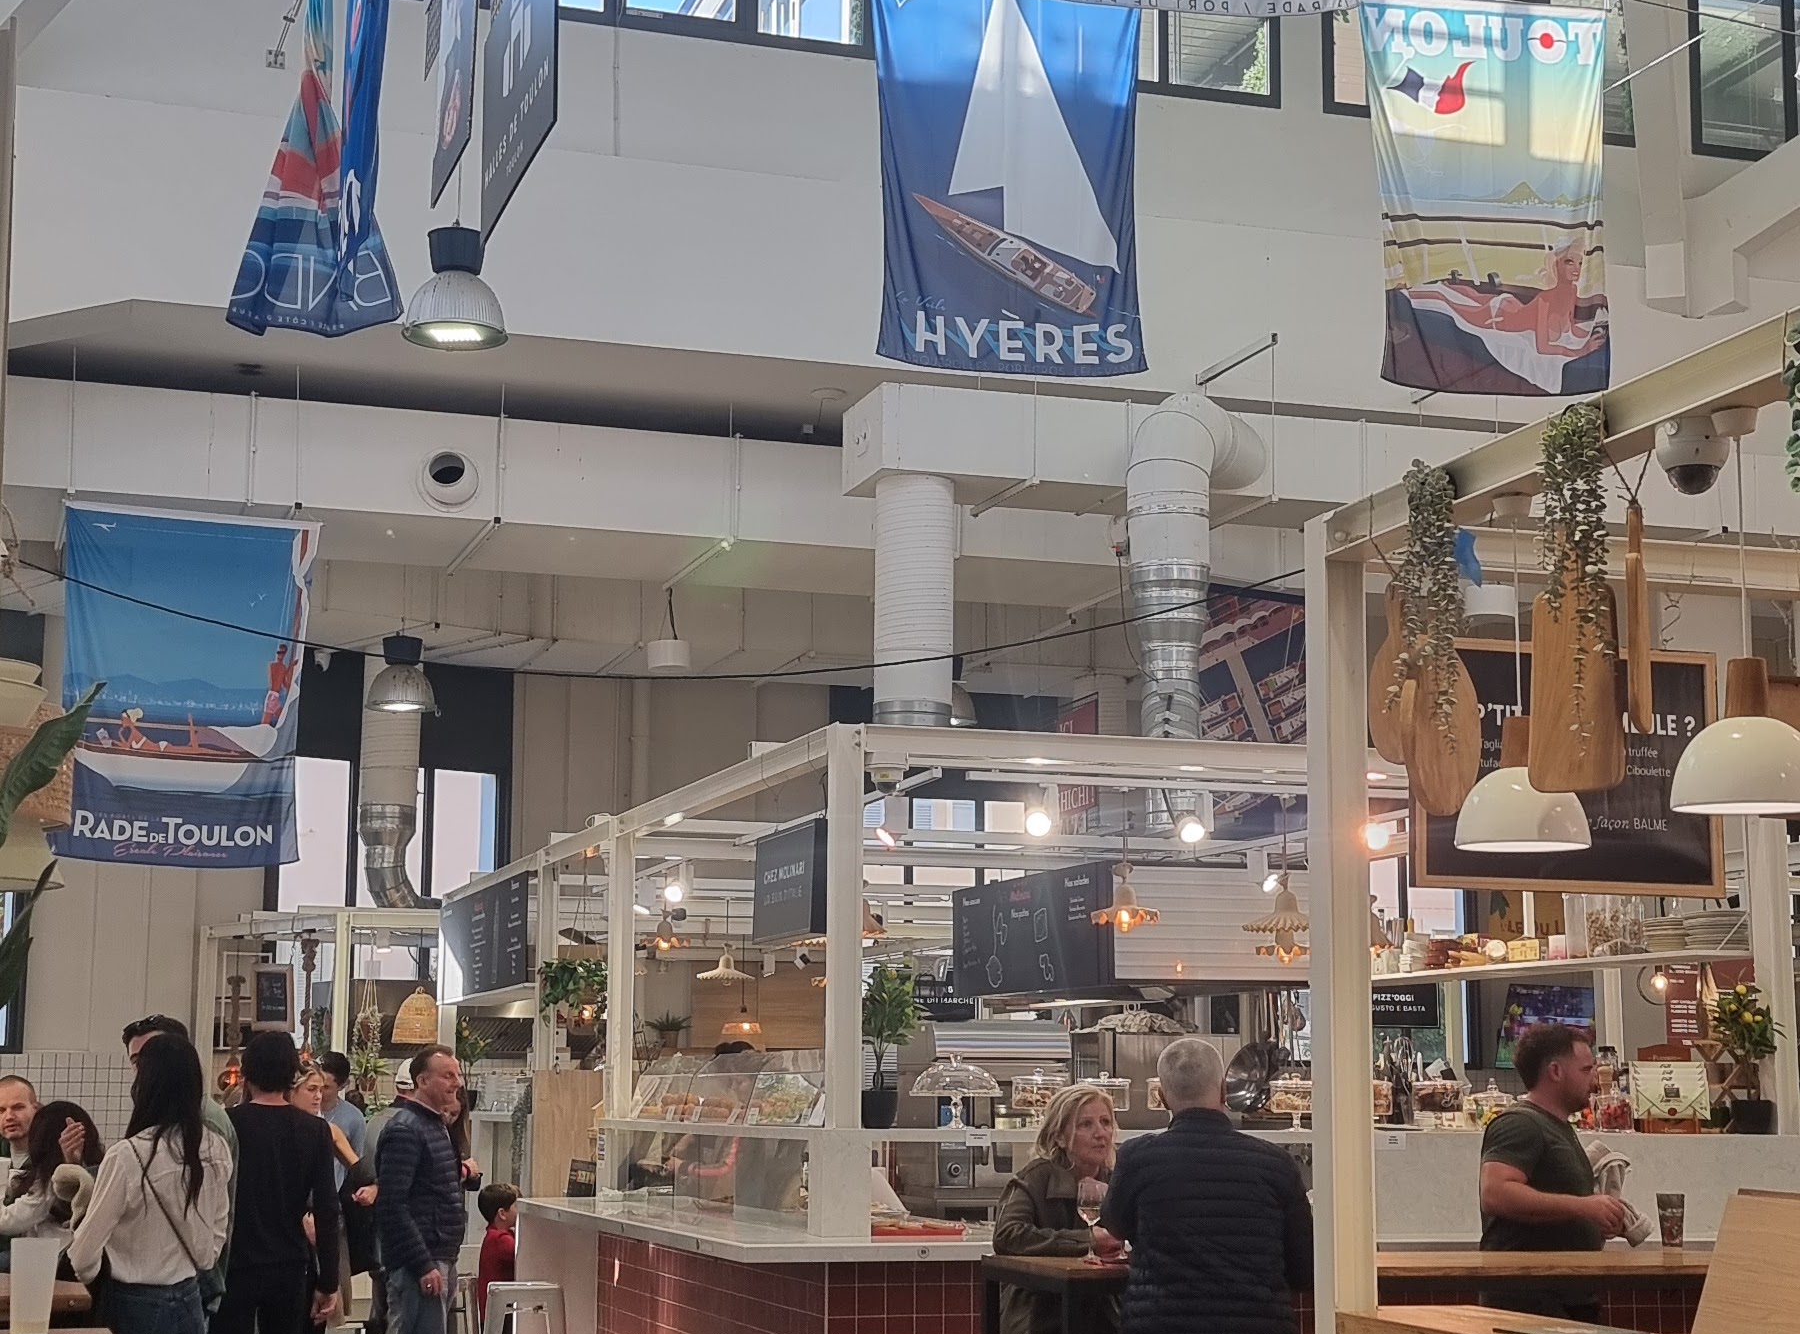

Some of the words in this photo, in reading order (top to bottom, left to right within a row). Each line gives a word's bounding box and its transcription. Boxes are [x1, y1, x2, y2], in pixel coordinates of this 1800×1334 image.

[484, 137, 508, 191] HALLES
[509, 113, 518, 144] DE
[519, 56, 550, 122] TOULON
[914, 308, 1135, 365] HYÈRES
[1626, 764, 1671, 777] Ciboulette
[1060, 785, 1089, 813] HICHI
[72, 809, 149, 843] RADE
[162, 817, 273, 847] TOULON
[1633, 817, 1669, 832] BALME
